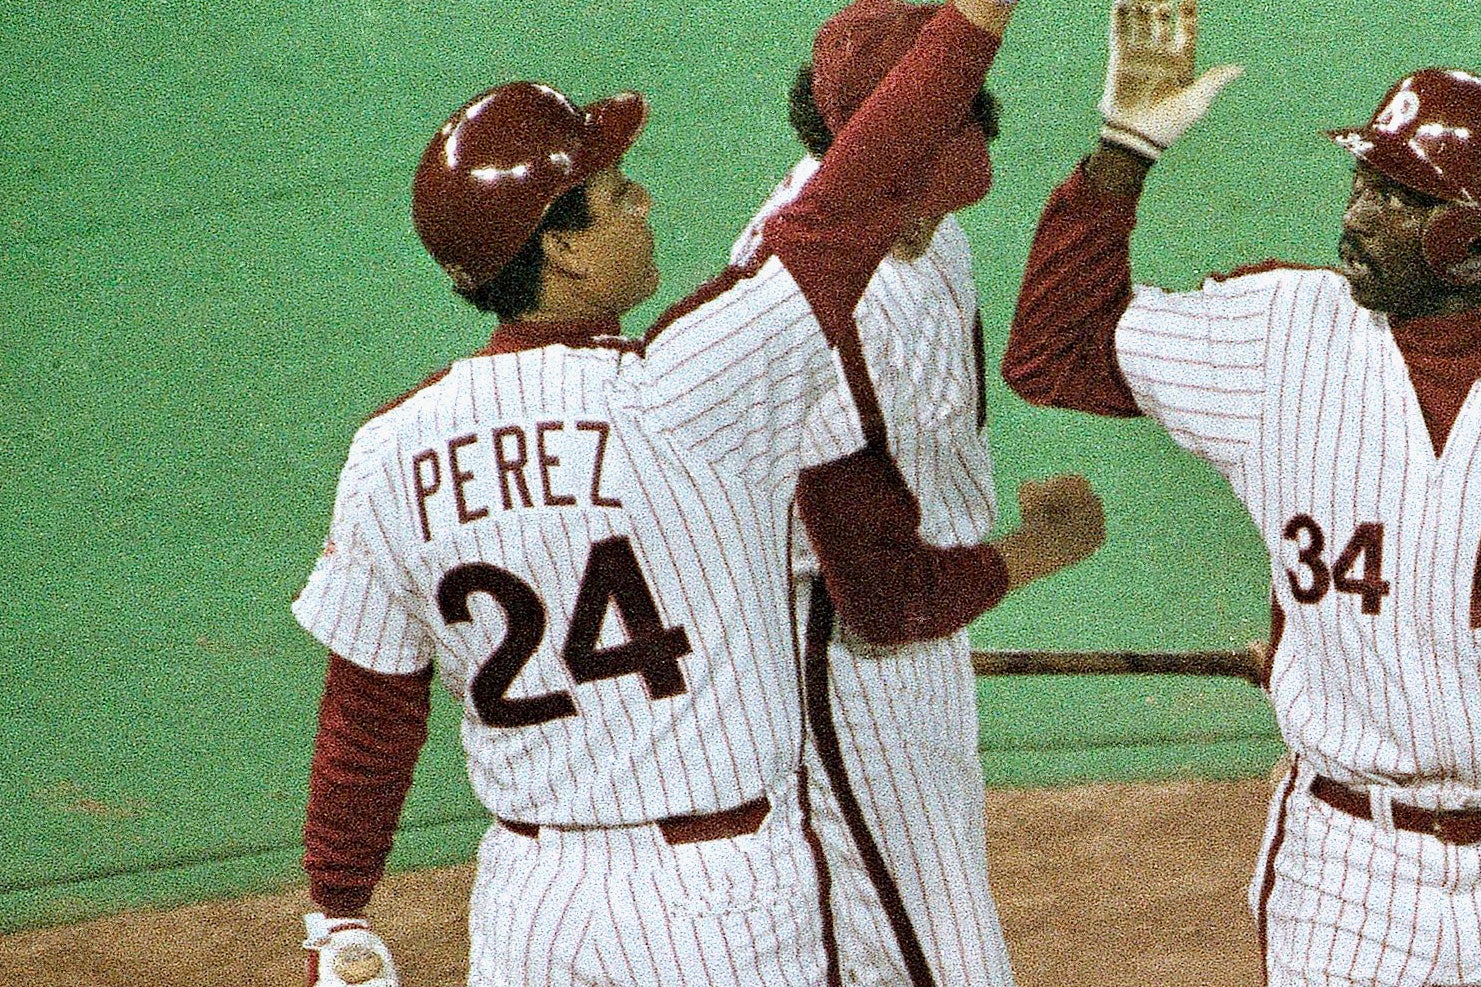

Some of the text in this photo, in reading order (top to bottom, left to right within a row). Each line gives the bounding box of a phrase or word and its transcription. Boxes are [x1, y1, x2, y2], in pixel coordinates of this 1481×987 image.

[412, 421, 623, 541] PEREZ
[1283, 513, 1390, 615] 34
[436, 535, 694, 728] 24
